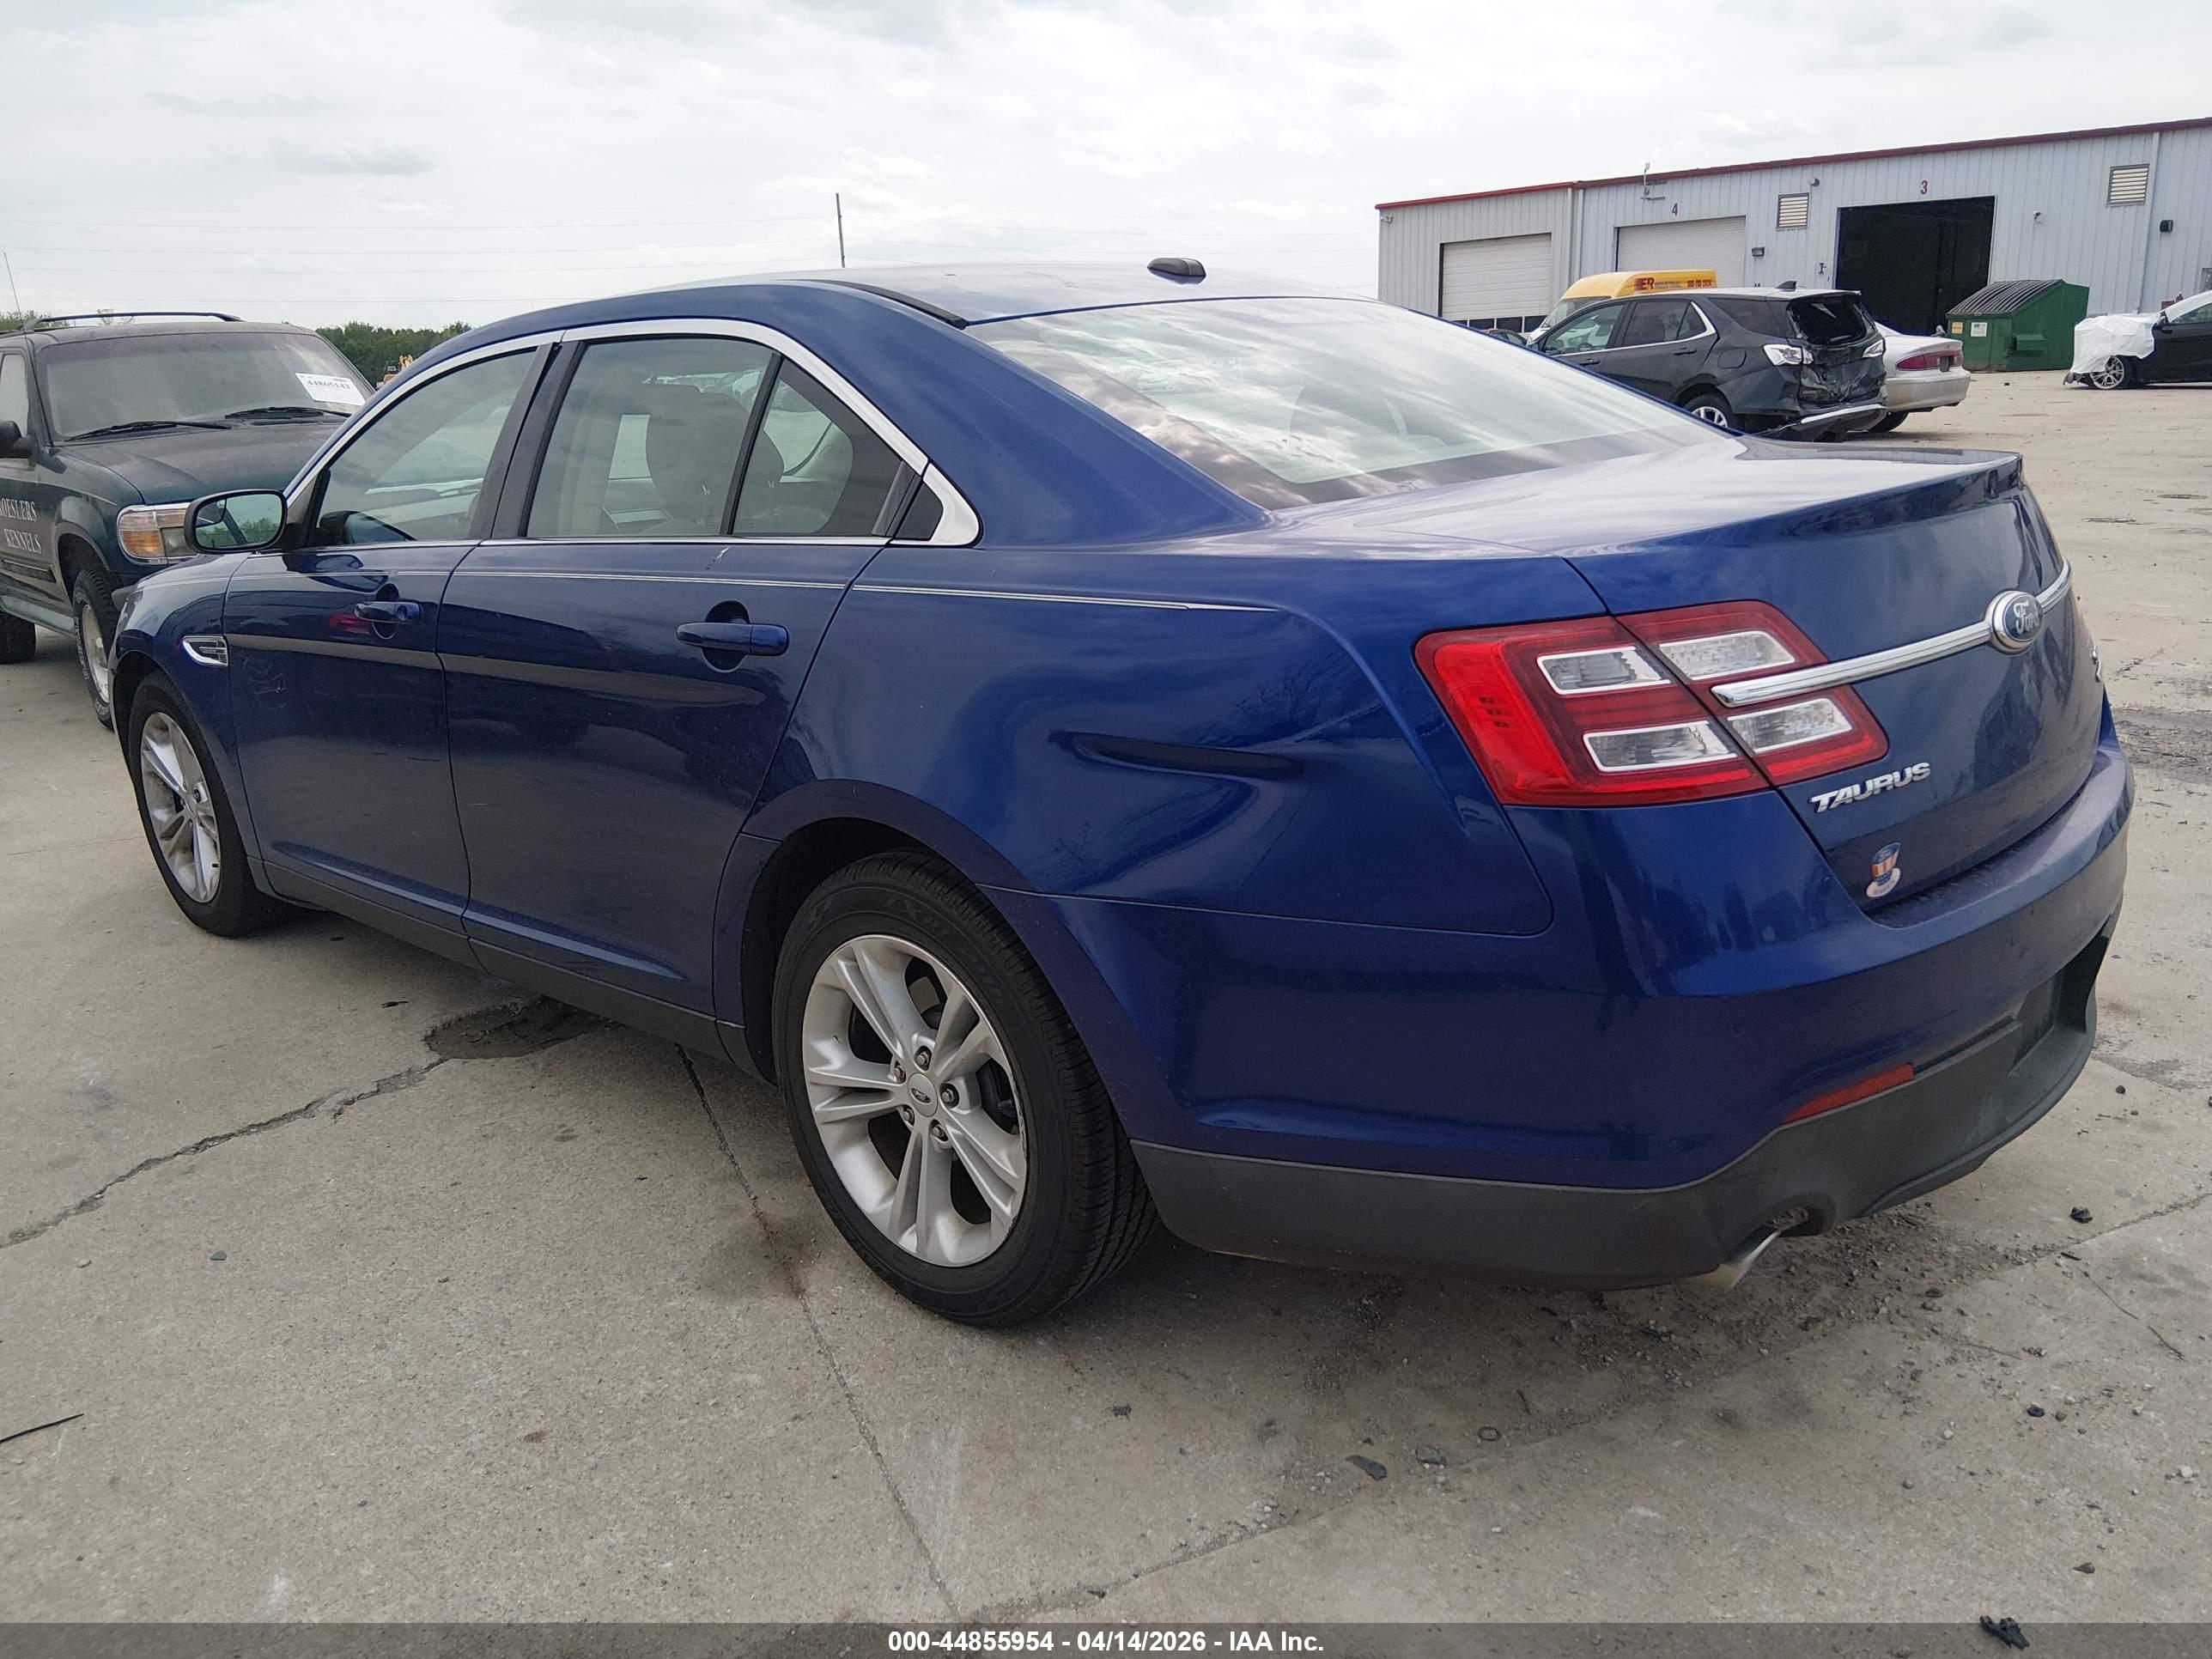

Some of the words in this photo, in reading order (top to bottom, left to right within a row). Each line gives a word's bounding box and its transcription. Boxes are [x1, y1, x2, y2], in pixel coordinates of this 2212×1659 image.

[1920, 179, 1928, 195] 3
[1671, 202, 1679, 216] 4
[0, 497, 37, 522] OESLERS
[3, 528, 42, 555] KENNELS
[2013, 599, 2040, 635] Ford
[1809, 762, 1931, 813] TAURUS
